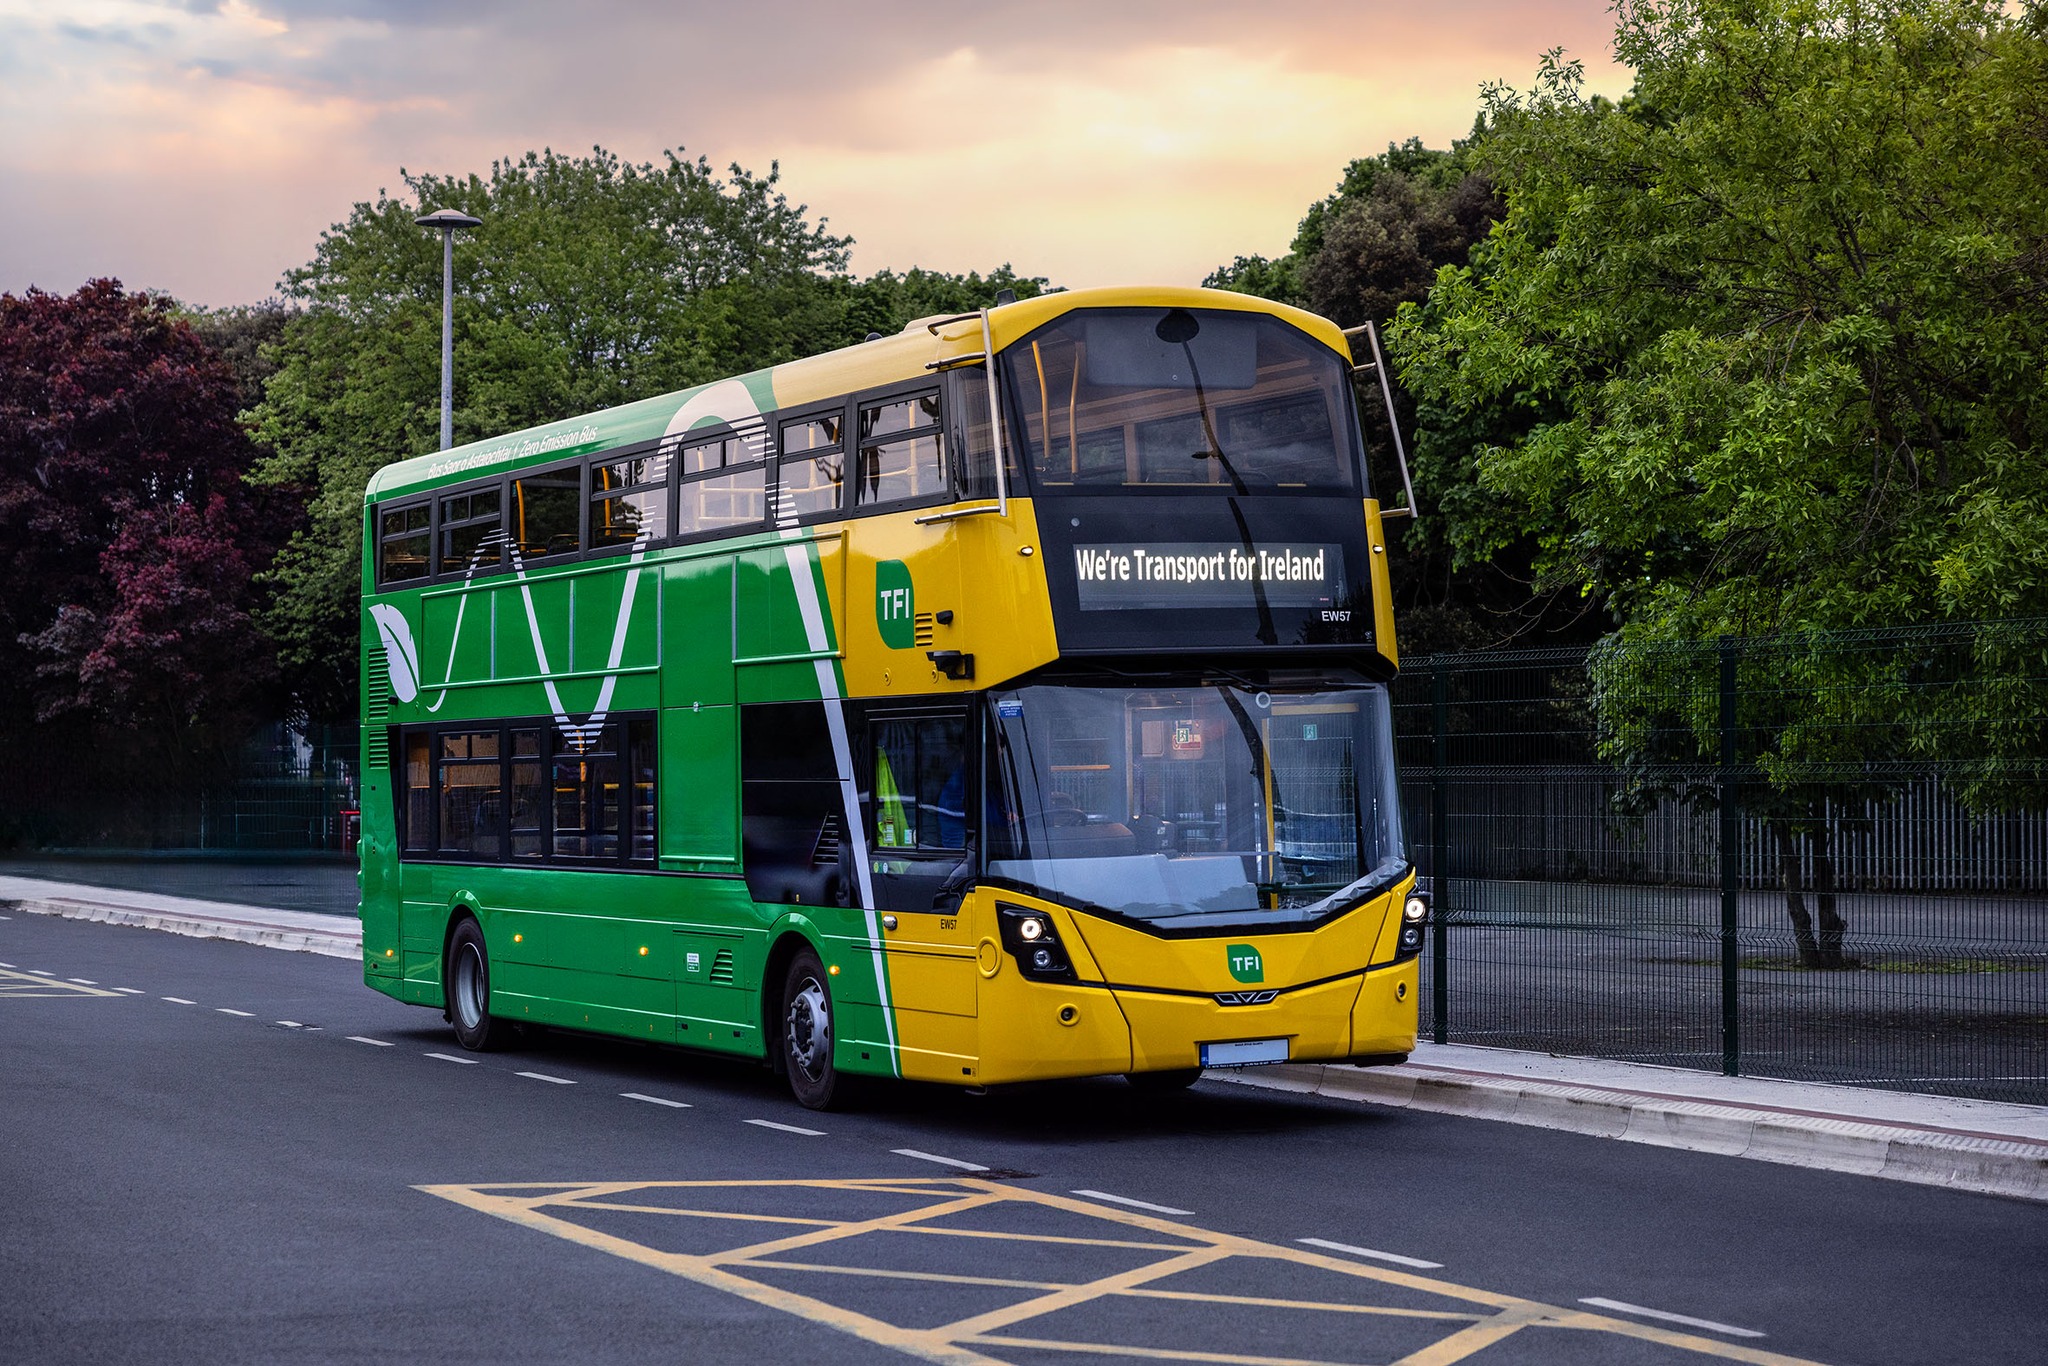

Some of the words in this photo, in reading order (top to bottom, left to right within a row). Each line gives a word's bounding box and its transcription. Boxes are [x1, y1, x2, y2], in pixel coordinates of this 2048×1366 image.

[427, 462, 443, 480] Bus
[519, 440, 540, 458] Zero
[540, 430, 580, 452] Emission
[580, 425, 598, 442] Bus
[1076, 549, 1130, 581] We're
[1134, 548, 1225, 584] Transport
[1229, 548, 1256, 581] for
[1259, 549, 1324, 581] Ireland
[880, 587, 910, 620] TFI
[1321, 610, 1351, 622] EW57
[940, 918, 957, 930] EW57
[1232, 956, 1259, 971] TFI
